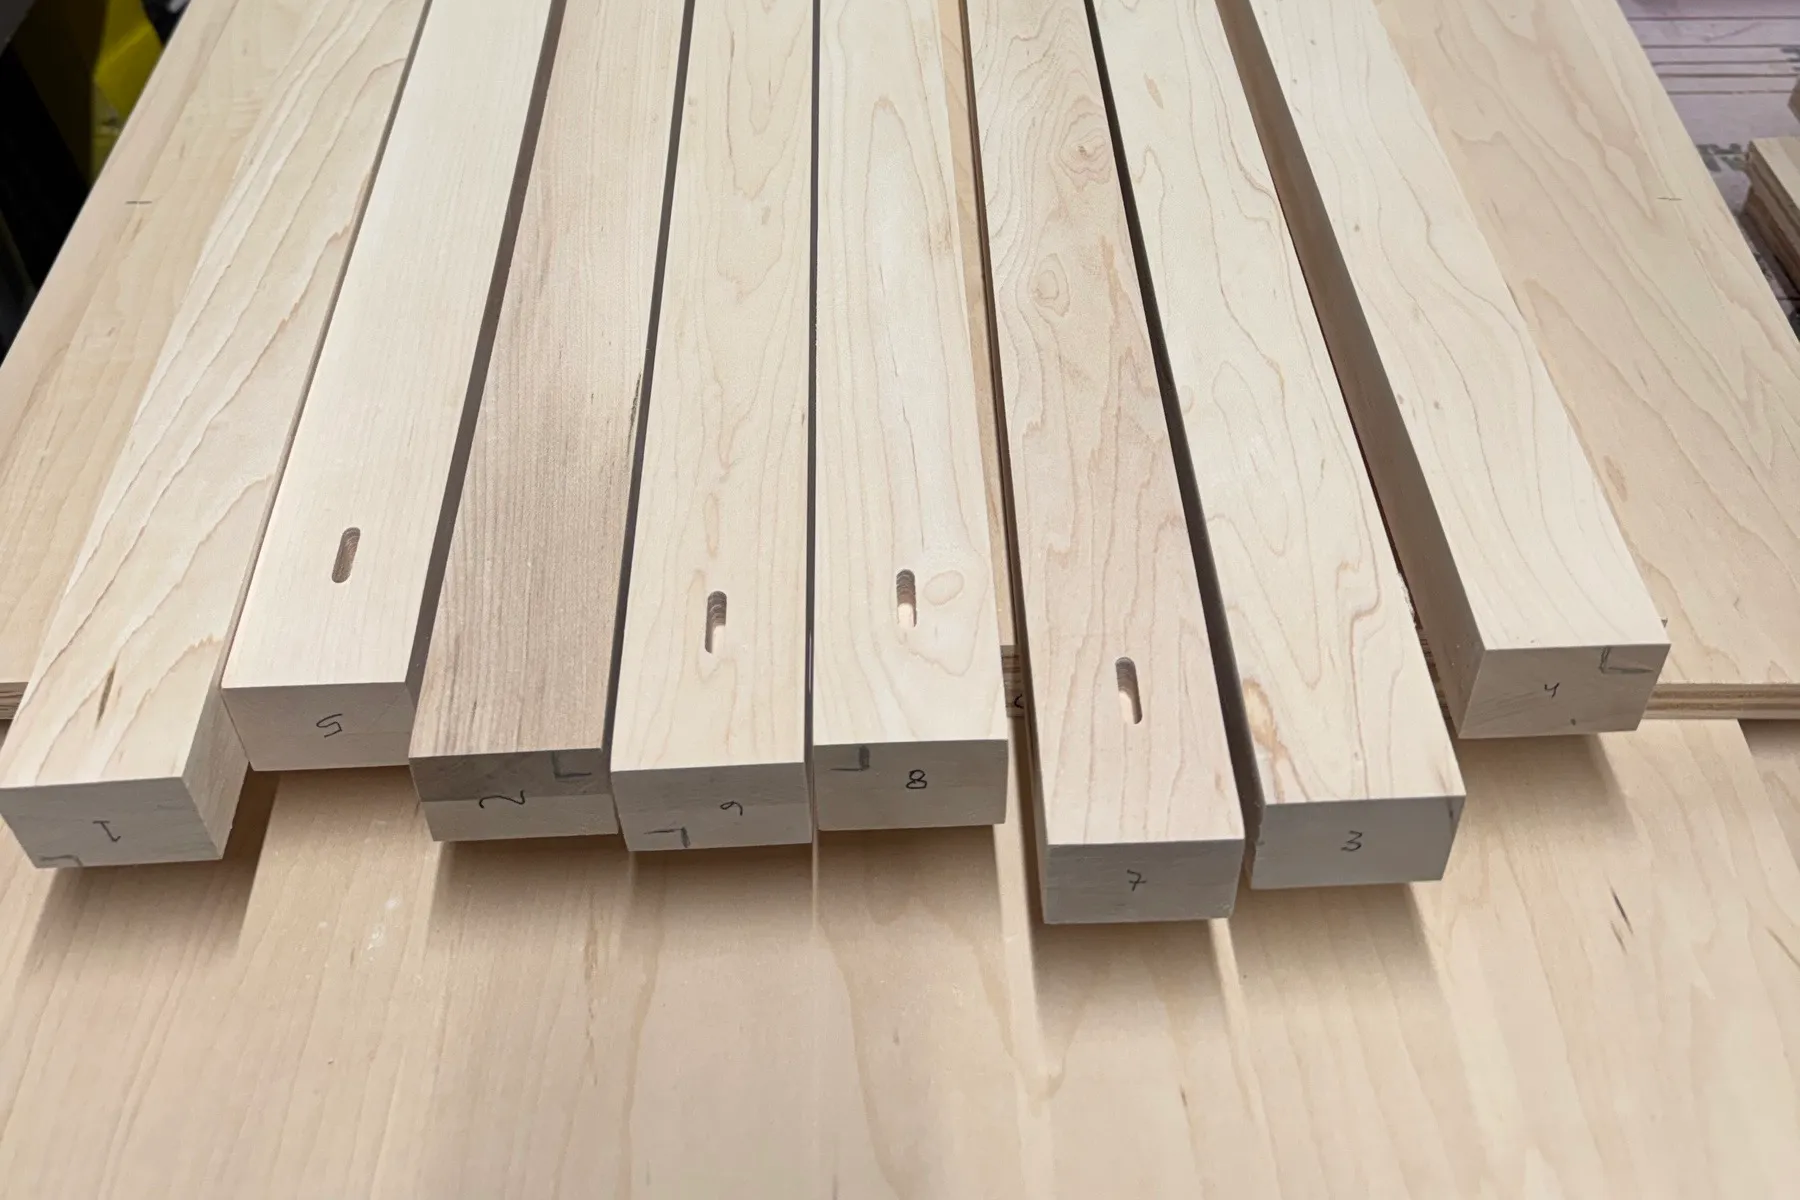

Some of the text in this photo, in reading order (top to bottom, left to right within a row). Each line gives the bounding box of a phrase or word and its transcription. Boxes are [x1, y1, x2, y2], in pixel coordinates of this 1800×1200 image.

[905, 769, 928, 790] 8
[1340, 829, 1363, 852] 3
[1126, 869, 1147, 892] 7
